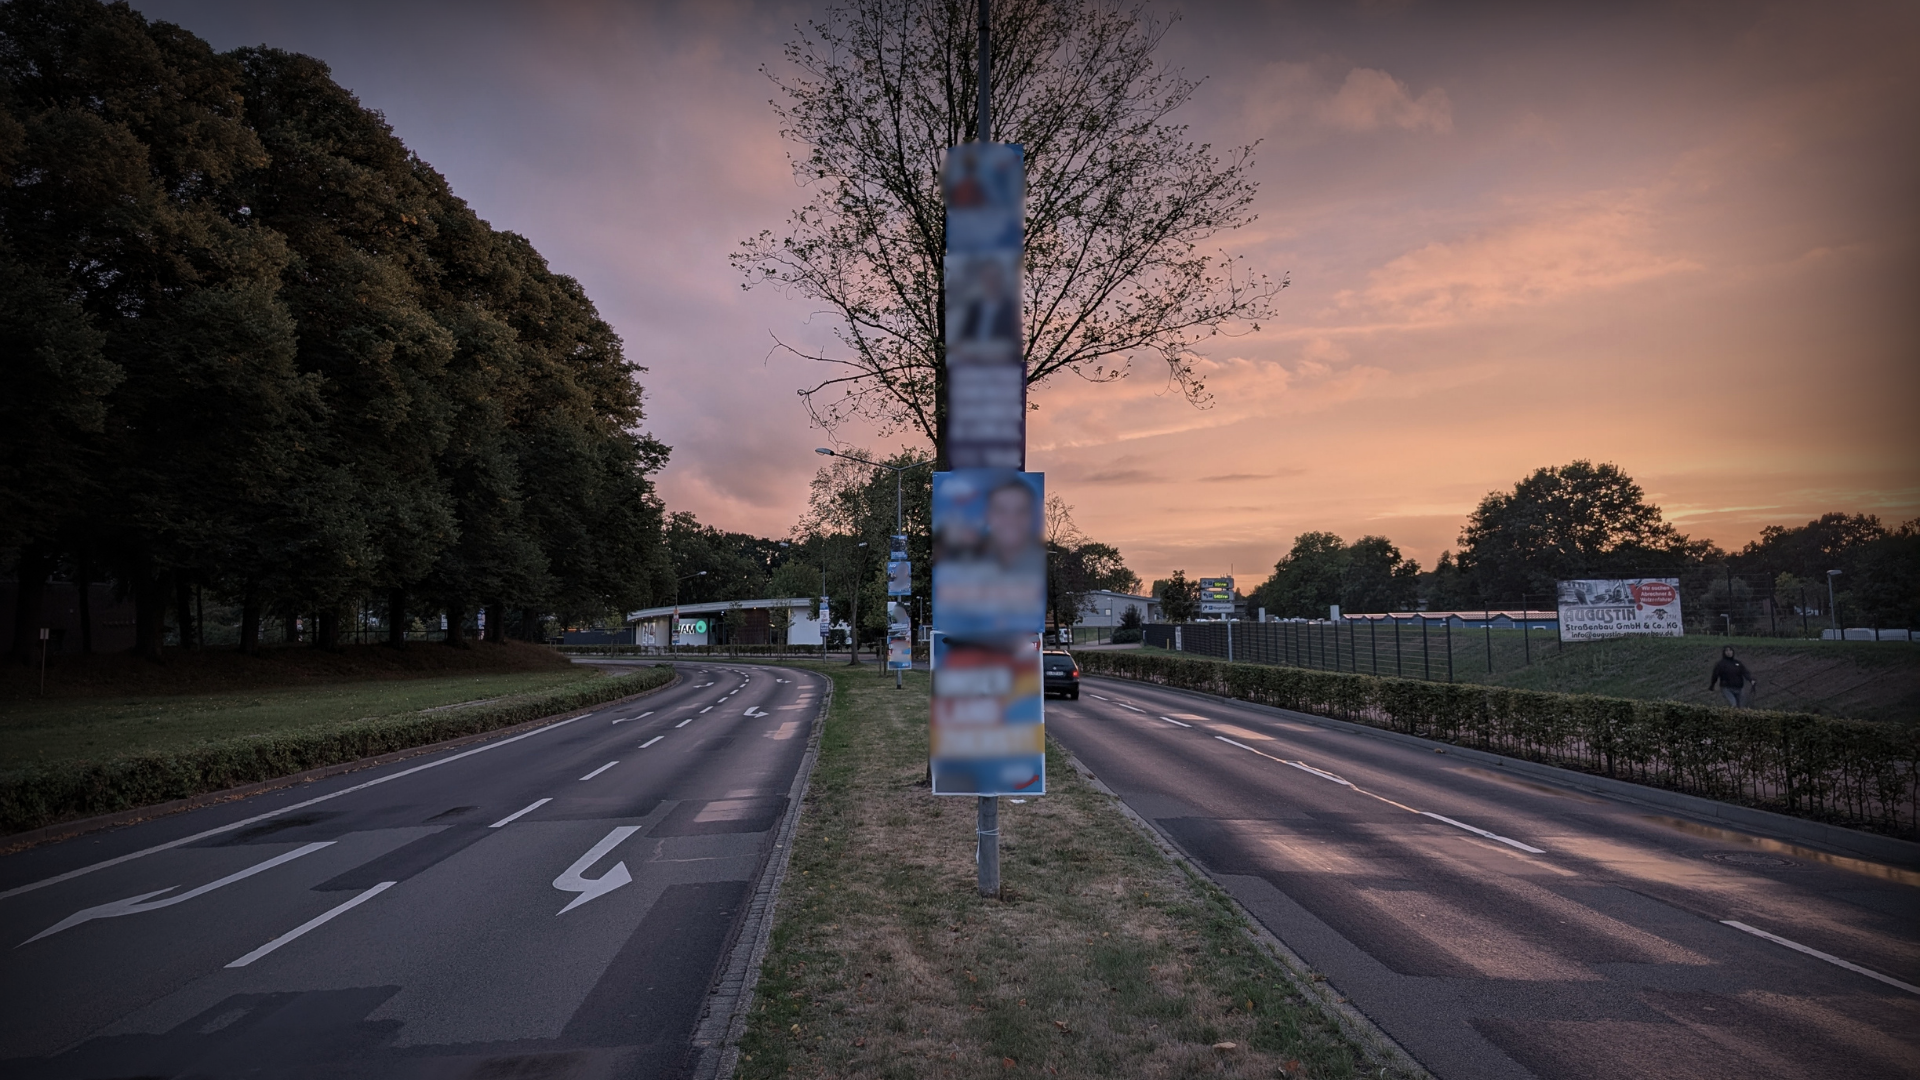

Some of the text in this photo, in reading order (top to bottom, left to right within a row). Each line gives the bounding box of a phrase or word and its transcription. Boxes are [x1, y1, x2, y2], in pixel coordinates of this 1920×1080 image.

[1565, 623, 1614, 631] Straßenbau
[1616, 622, 1641, 630] GmbH
[1643, 622, 1650, 630] &
